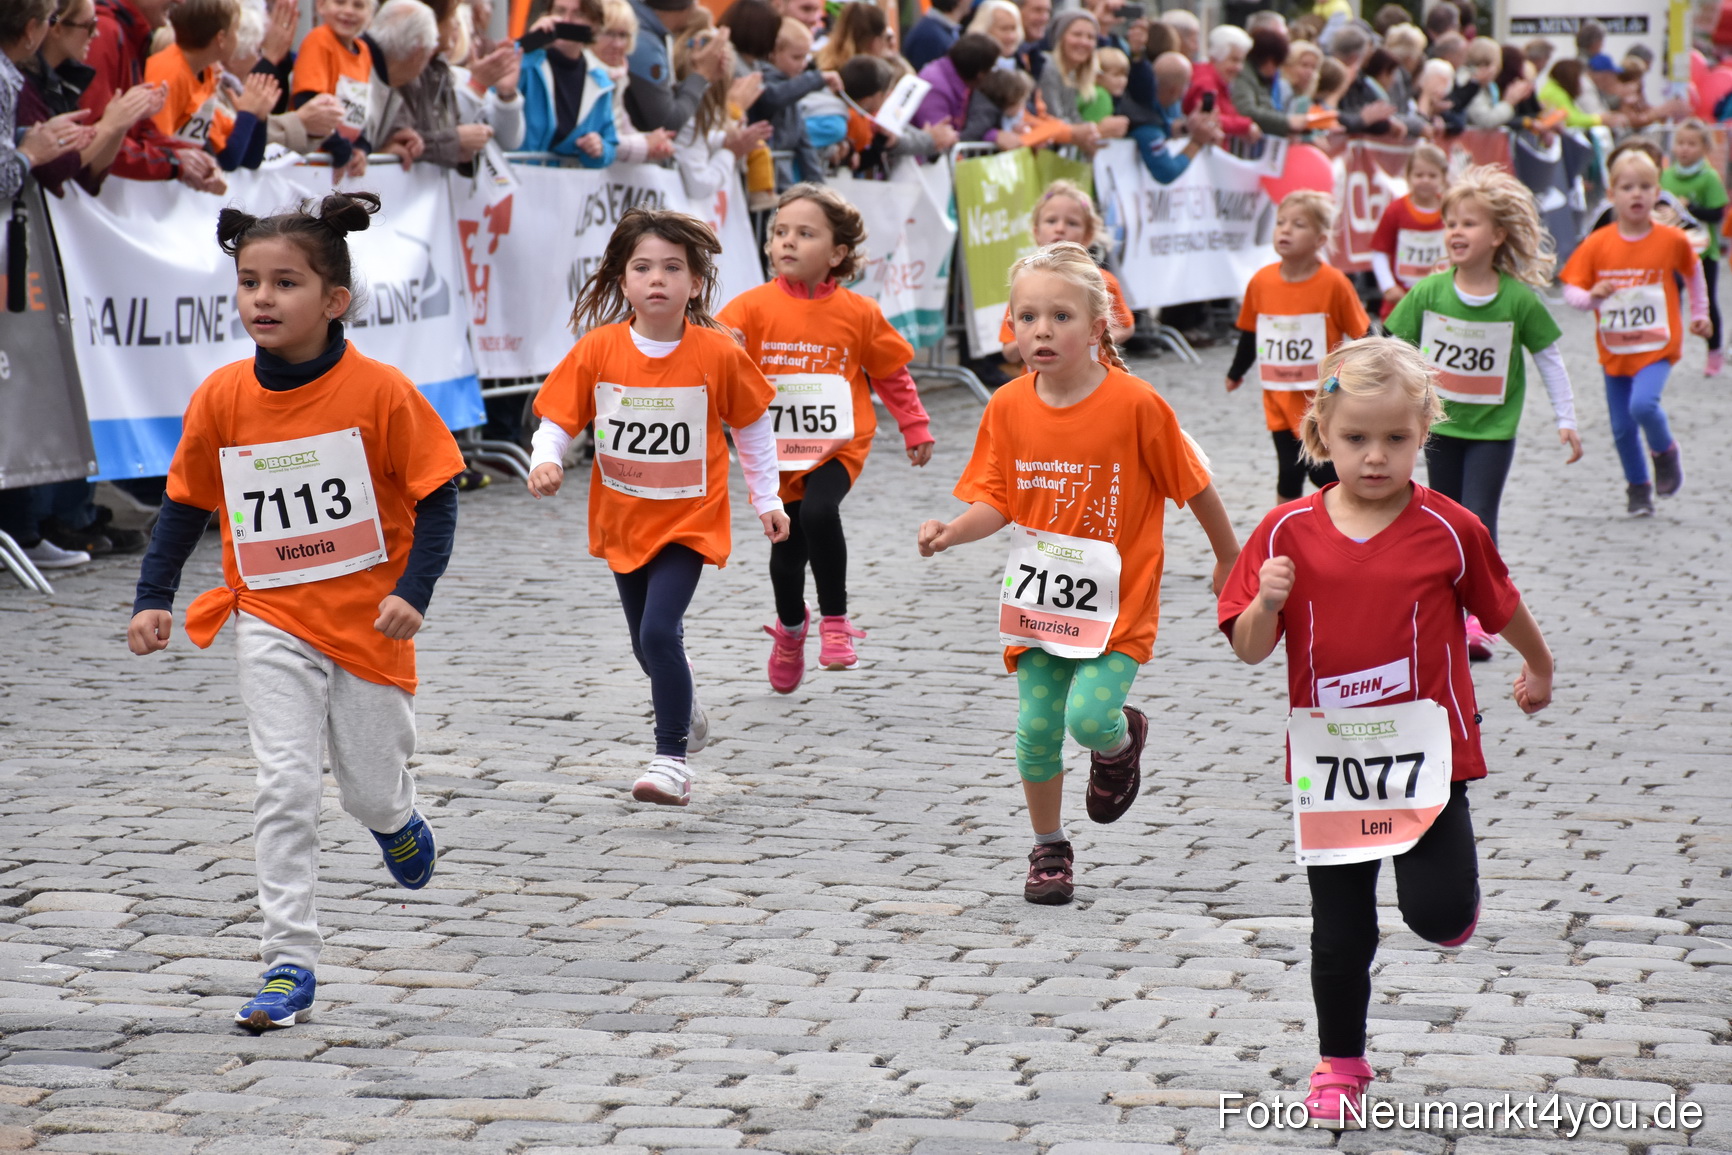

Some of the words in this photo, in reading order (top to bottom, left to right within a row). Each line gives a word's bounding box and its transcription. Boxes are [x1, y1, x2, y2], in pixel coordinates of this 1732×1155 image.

[84, 295, 228, 346] RAIL.ONE
[1608, 305, 1656, 329] 7120
[1265, 338, 1314, 361] 7162
[1433, 339, 1496, 371] 7236
[632, 397, 675, 408] BOCK
[768, 405, 837, 433] 7155
[608, 418, 690, 455] 7220
[266, 450, 319, 469] BOCK
[782, 443, 823, 454] Johanna
[1015, 459, 1084, 474] Neumarkter
[1016, 476, 1067, 493] Stadtlauf
[243, 477, 352, 533] 7113
[1107, 463, 1121, 538] BAMBINI
[236, 529, 244, 537] B1
[275, 539, 336, 561] Victoria
[1045, 542, 1084, 560] BOCK
[1014, 563, 1098, 613] 7132
[1019, 614, 1080, 637] Franziska
[1340, 676, 1383, 699] DEHN
[1339, 720, 1397, 736] BOCK
[1315, 752, 1426, 801] 7077
[1300, 796, 1311, 806] B1
[1361, 818, 1393, 836] Leni
